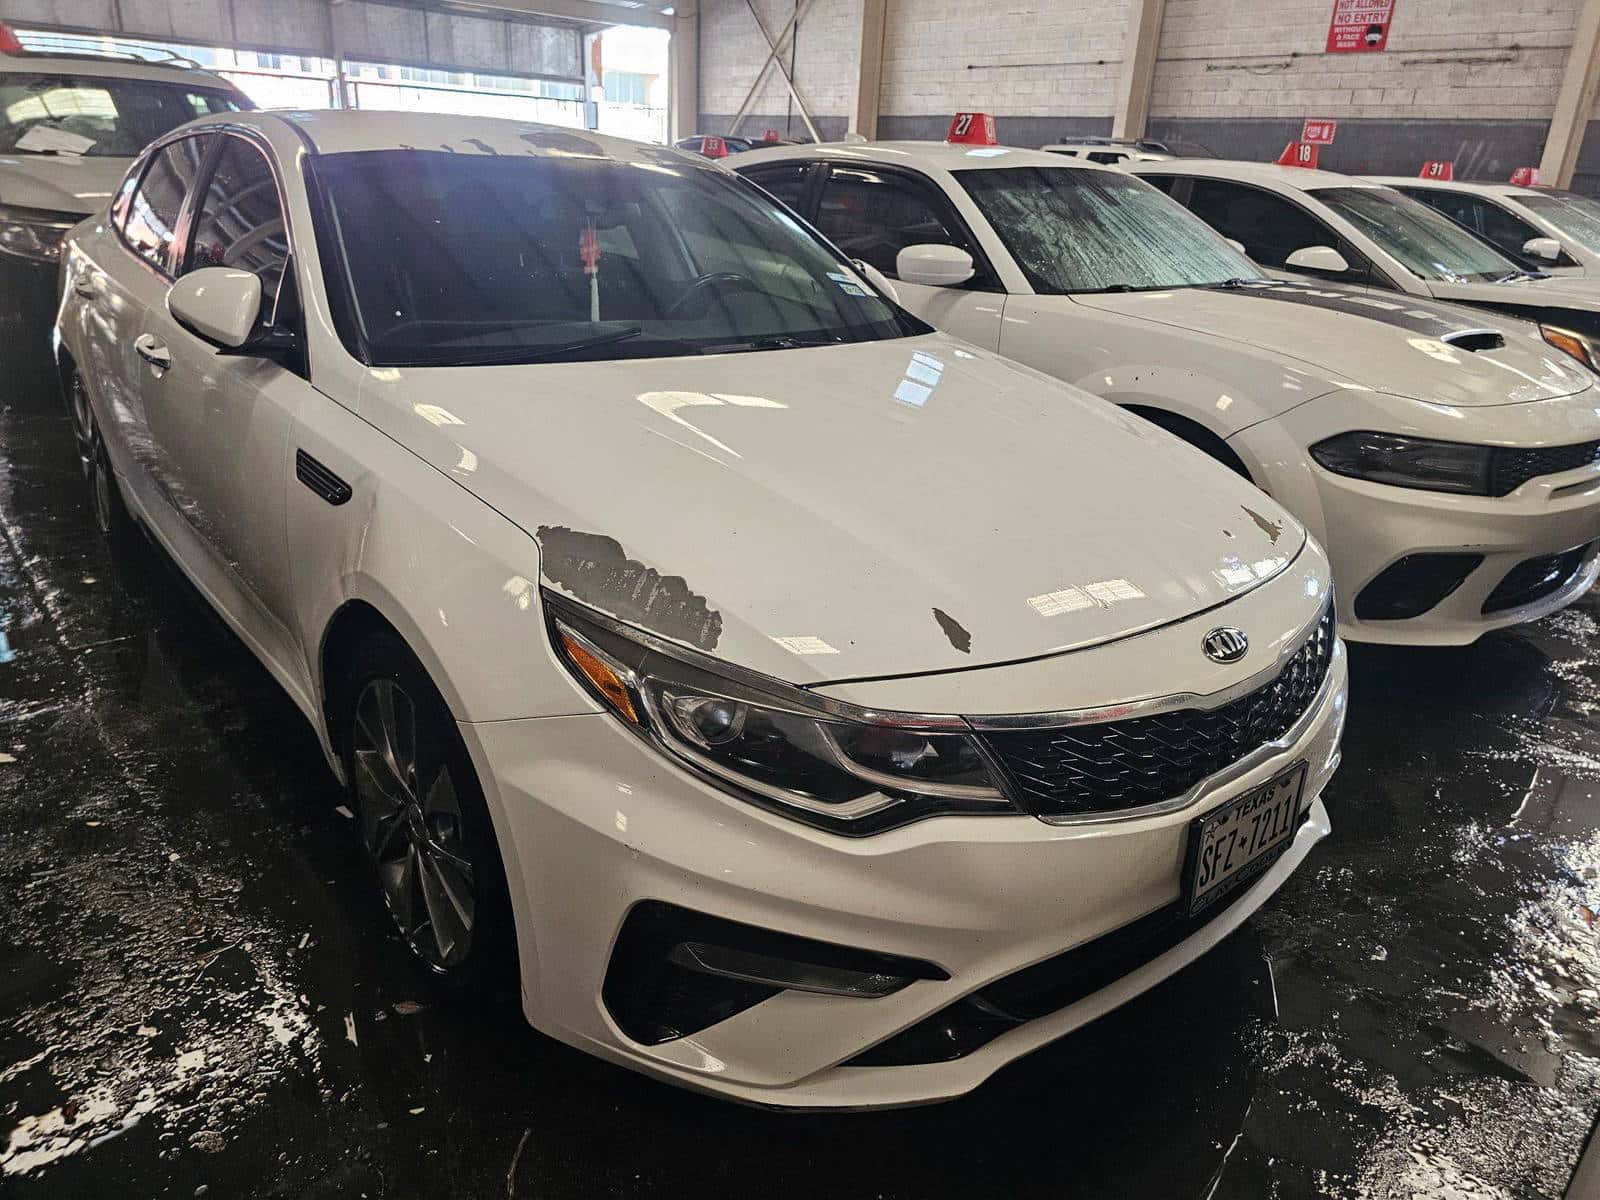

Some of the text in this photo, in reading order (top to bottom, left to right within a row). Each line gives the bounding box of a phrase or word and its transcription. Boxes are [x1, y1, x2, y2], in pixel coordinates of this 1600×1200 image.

[1337, 12, 1386, 23] NO ENTRY
[955, 114, 974, 135] 27
[1299, 144, 1311, 162] 18
[1429, 162, 1444, 176] 31
[1236, 786, 1275, 821] TEXAS
